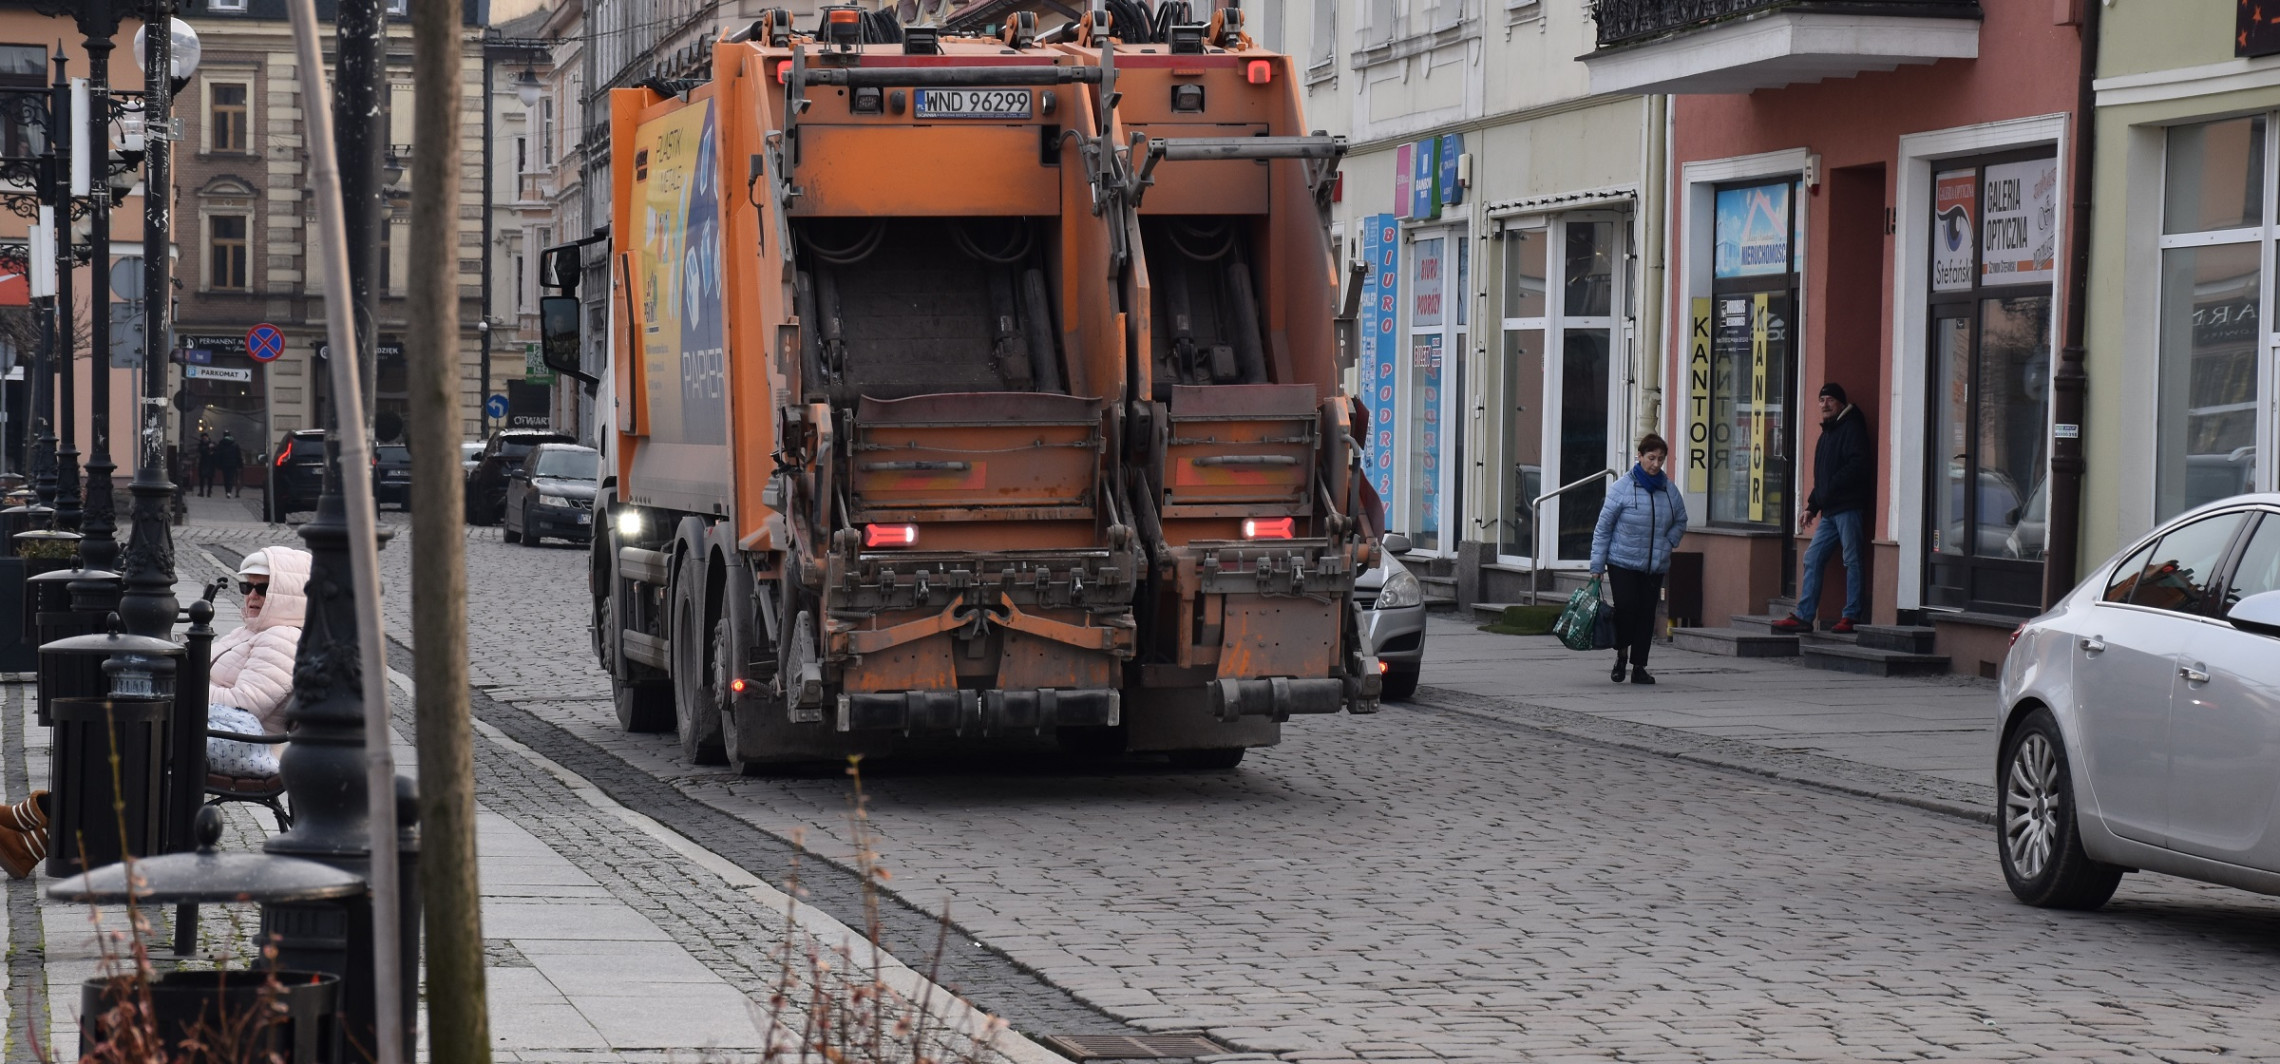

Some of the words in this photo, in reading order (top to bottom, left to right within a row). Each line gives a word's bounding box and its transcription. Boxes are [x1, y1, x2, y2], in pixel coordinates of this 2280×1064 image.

[926, 92, 963, 112] WND
[969, 92, 1028, 112] 96299
[1988, 178, 2020, 213] GALERIA
[1986, 216, 2027, 252] OPTYCZNA
[1381, 227, 1395, 333] BIURO
[1421, 258, 1438, 280] BIURO
[1416, 288, 1441, 316] PODRÓŻY
[201, 368, 239, 378] PARKOMAT
[683, 347, 724, 399] PAPIER
[1690, 317, 1709, 469] KANTOR
[1753, 305, 1765, 504] KANTOR
[1378, 363, 1392, 515] PODRÓŻY
